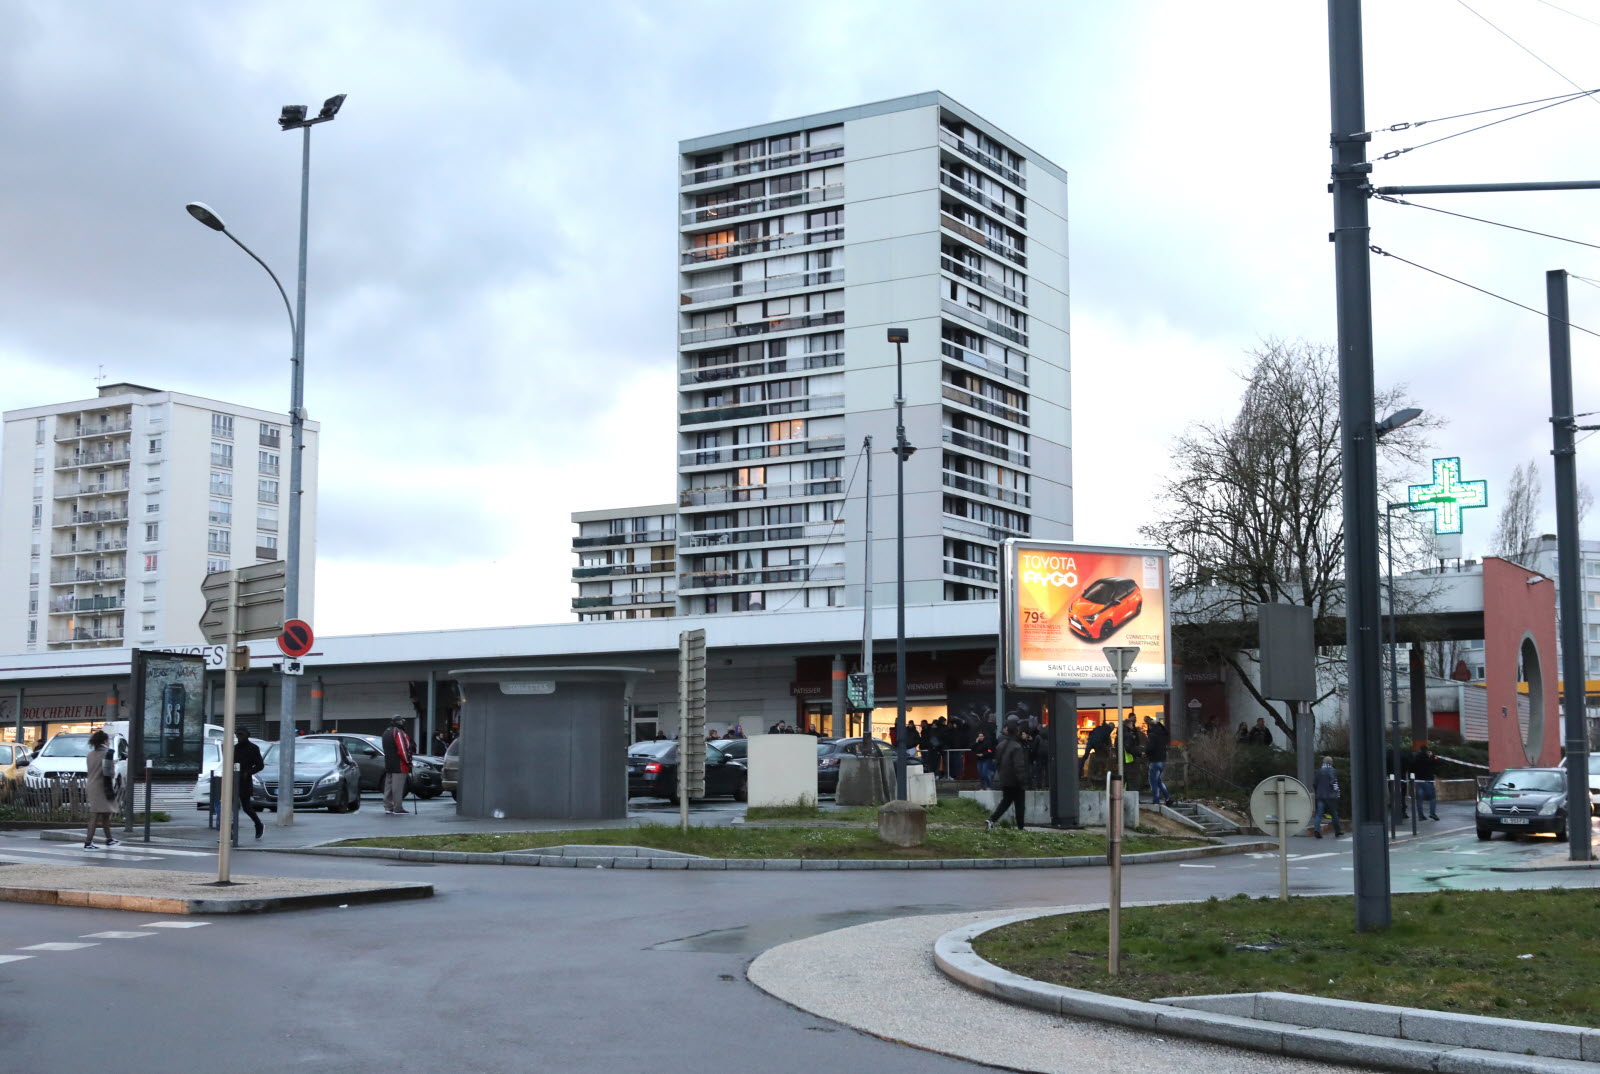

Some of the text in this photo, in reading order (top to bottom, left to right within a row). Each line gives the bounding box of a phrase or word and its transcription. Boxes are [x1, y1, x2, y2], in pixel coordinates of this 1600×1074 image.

[1023, 555, 1077, 571] TOYOTA
[1024, 570, 1079, 588] AYGO
[1067, 664, 1093, 672] CLAUDE
[906, 682, 945, 690] VIENNOISIER
[23, 706, 81, 719] BOUCHERIE
